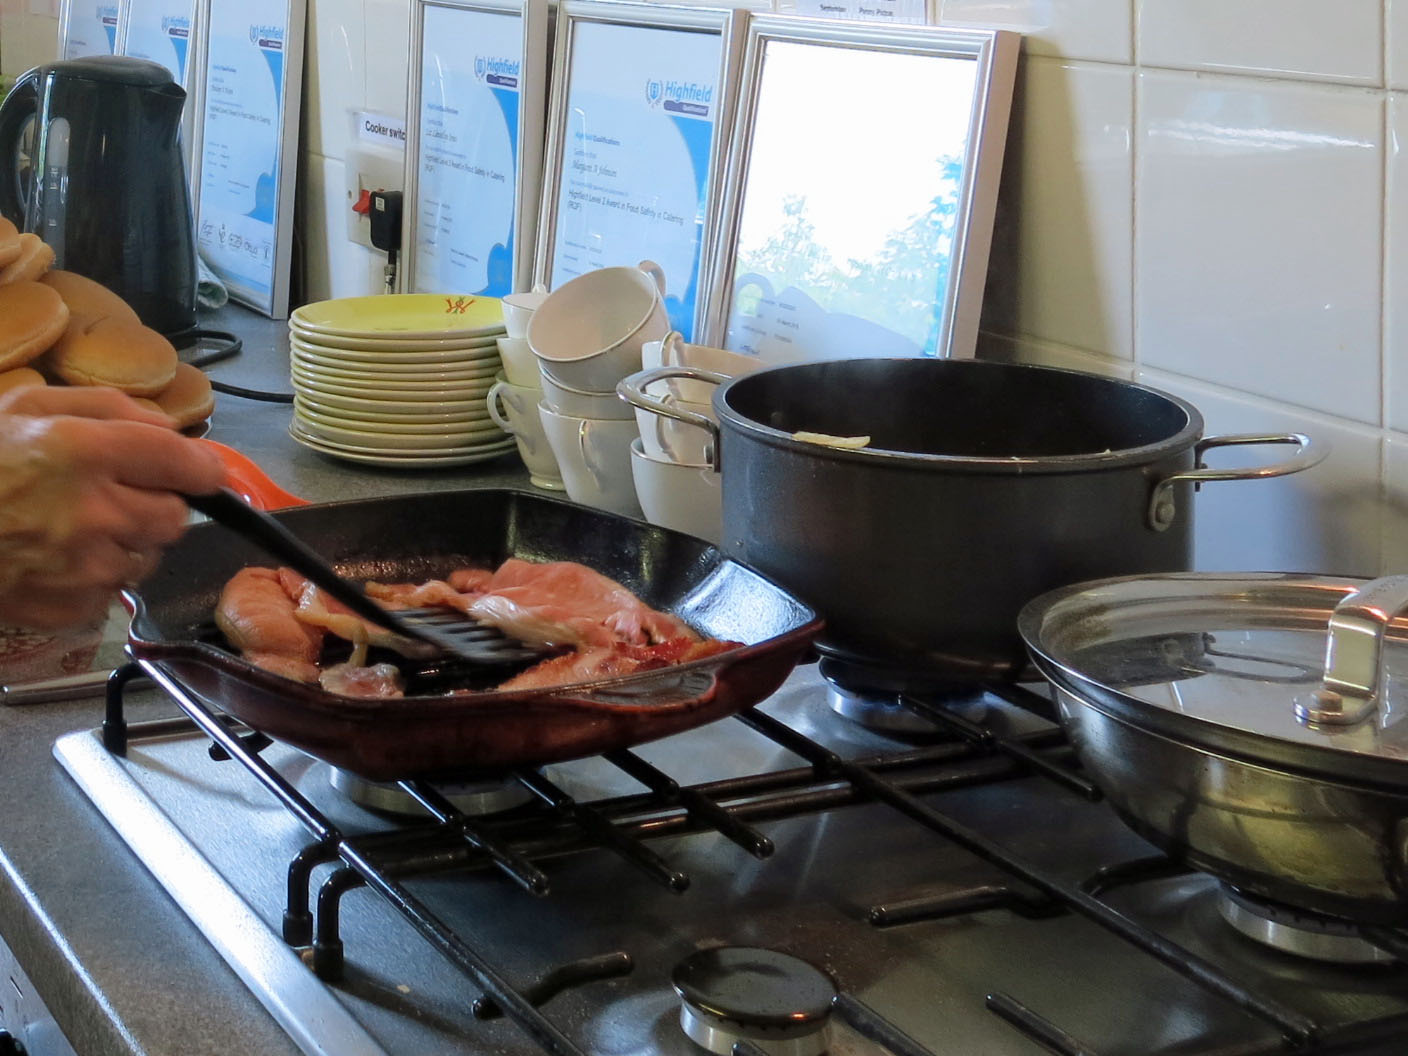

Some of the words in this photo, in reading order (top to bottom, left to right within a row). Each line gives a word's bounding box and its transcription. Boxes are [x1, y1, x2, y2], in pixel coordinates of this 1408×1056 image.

[486, 56, 520, 76] Highfield
[665, 80, 713, 103] Highfield
[365, 120, 388, 136] Cooker
[389, 127, 407, 141] switc
